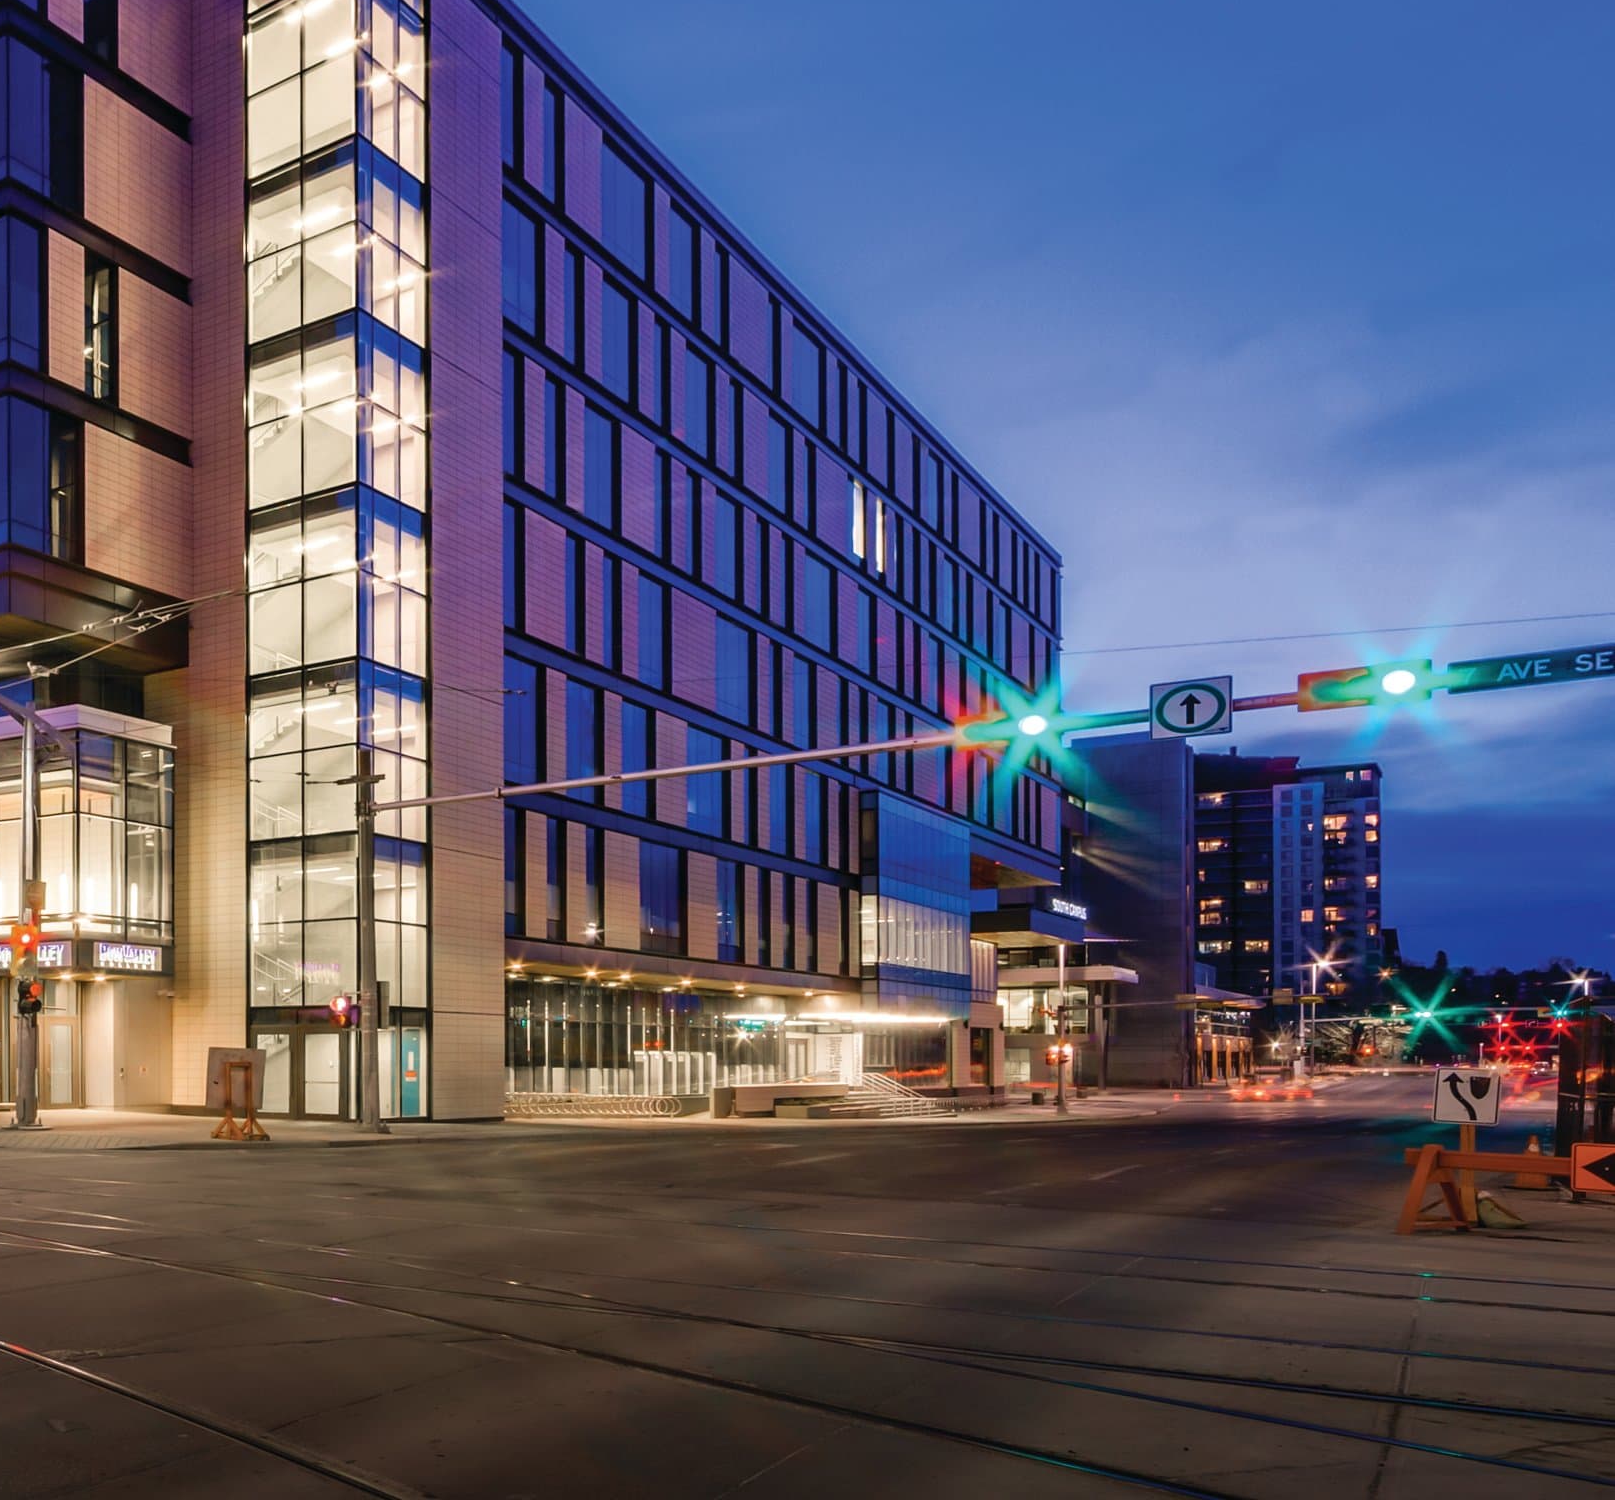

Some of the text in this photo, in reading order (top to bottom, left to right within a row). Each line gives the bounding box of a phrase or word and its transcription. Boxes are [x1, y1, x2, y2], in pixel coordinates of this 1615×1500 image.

[1460, 651, 1614, 685] 7 AVE SE
